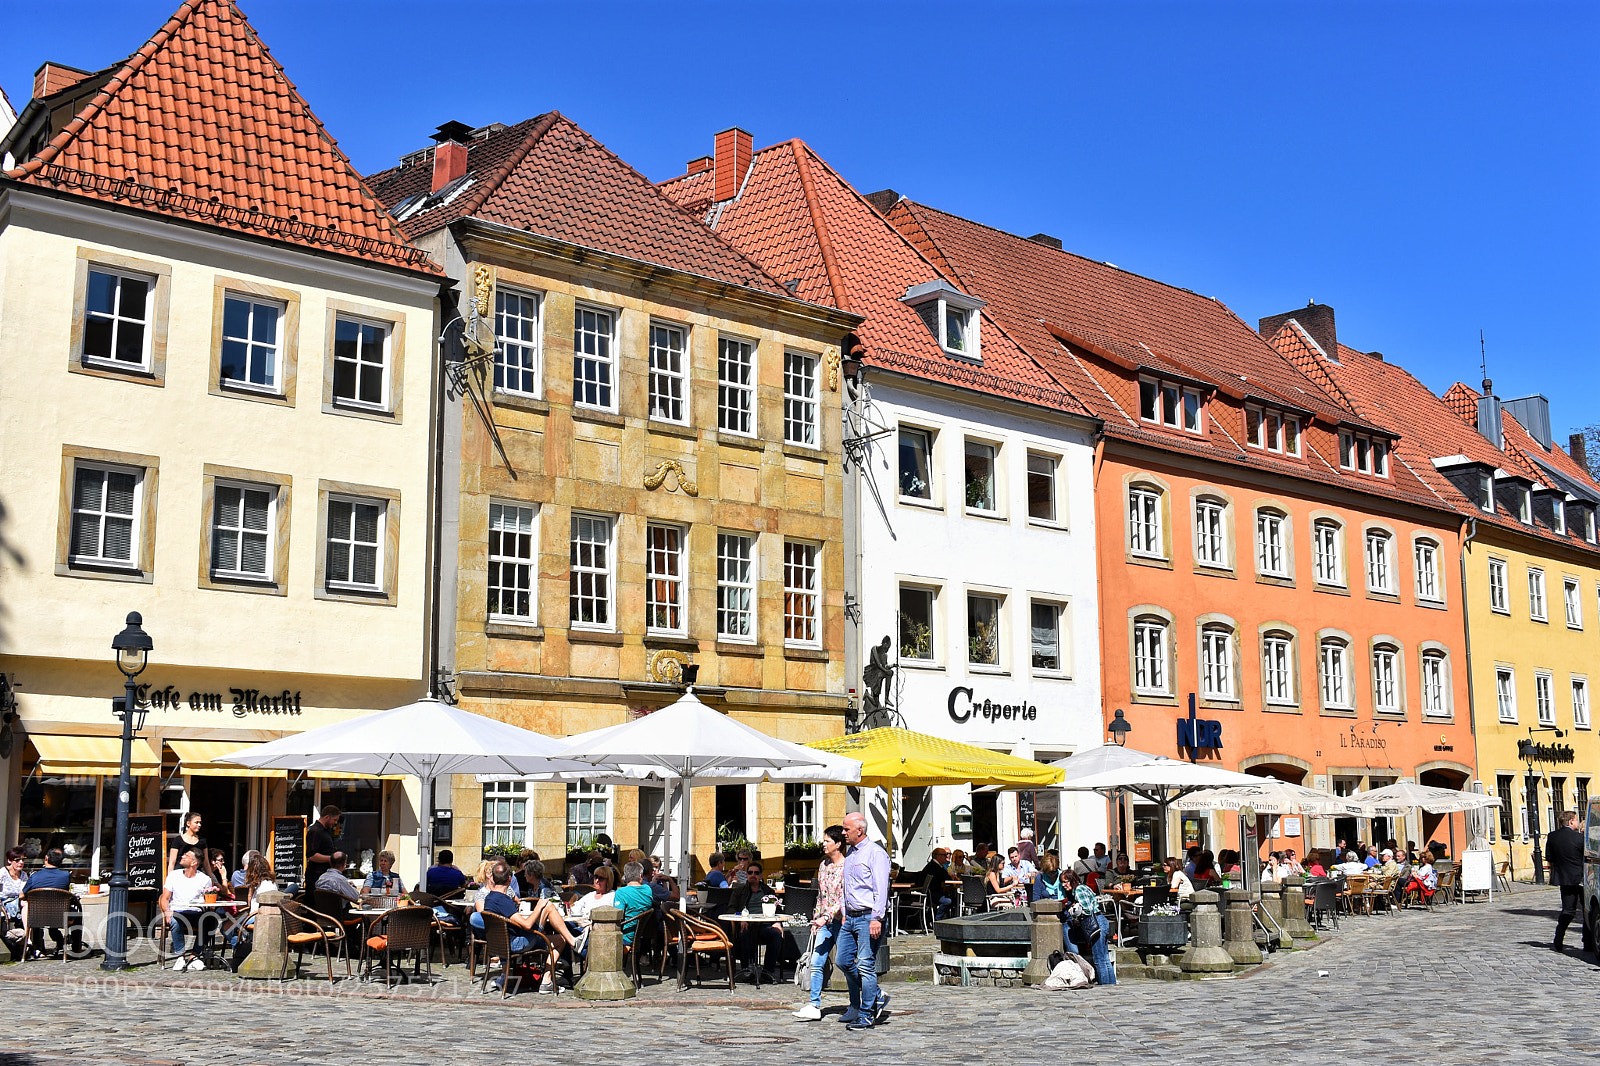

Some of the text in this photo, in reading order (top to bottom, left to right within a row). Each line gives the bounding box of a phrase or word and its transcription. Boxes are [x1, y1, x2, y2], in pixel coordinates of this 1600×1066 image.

[188, 690, 224, 713] am
[229, 686, 303, 718] Markt
[947, 685, 1037, 724] Crêperie
[1176, 718, 1224, 749] NDR
[1177, 799, 1212, 809] Espresso
[1219, 799, 1240, 808] Vino
[1249, 801, 1279, 811] Panino
